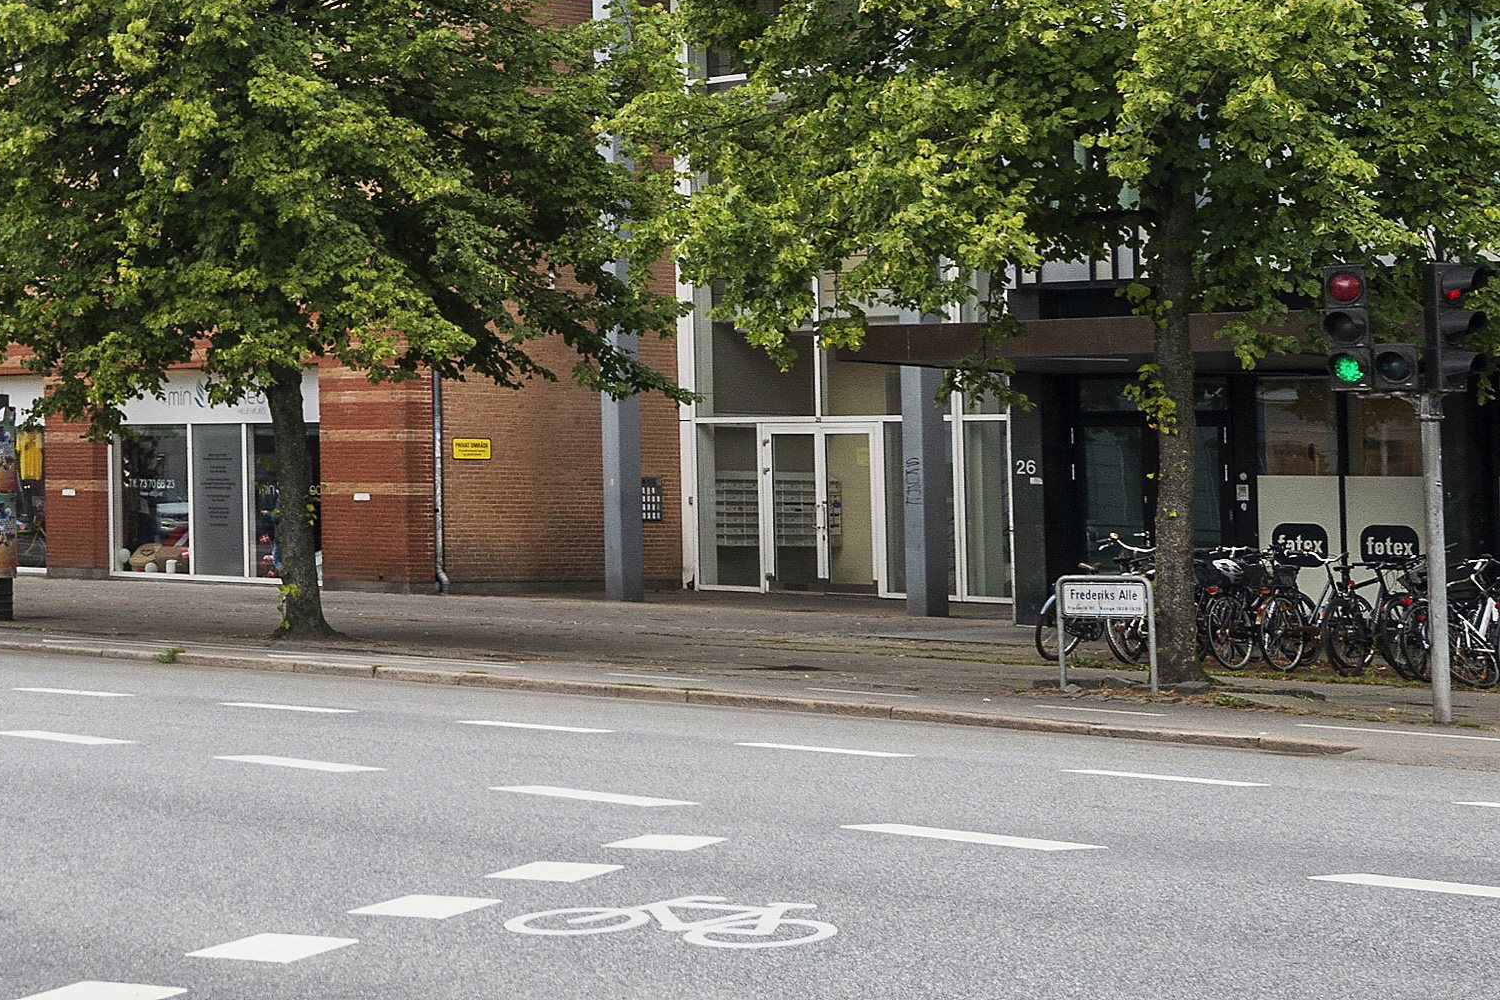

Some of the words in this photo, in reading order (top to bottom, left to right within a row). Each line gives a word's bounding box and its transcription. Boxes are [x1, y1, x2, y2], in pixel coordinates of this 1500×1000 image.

[1016, 460, 1036, 475] 26
[1366, 537, 1414, 555] føtex
[1070, 589, 1115, 600] Frederiks
